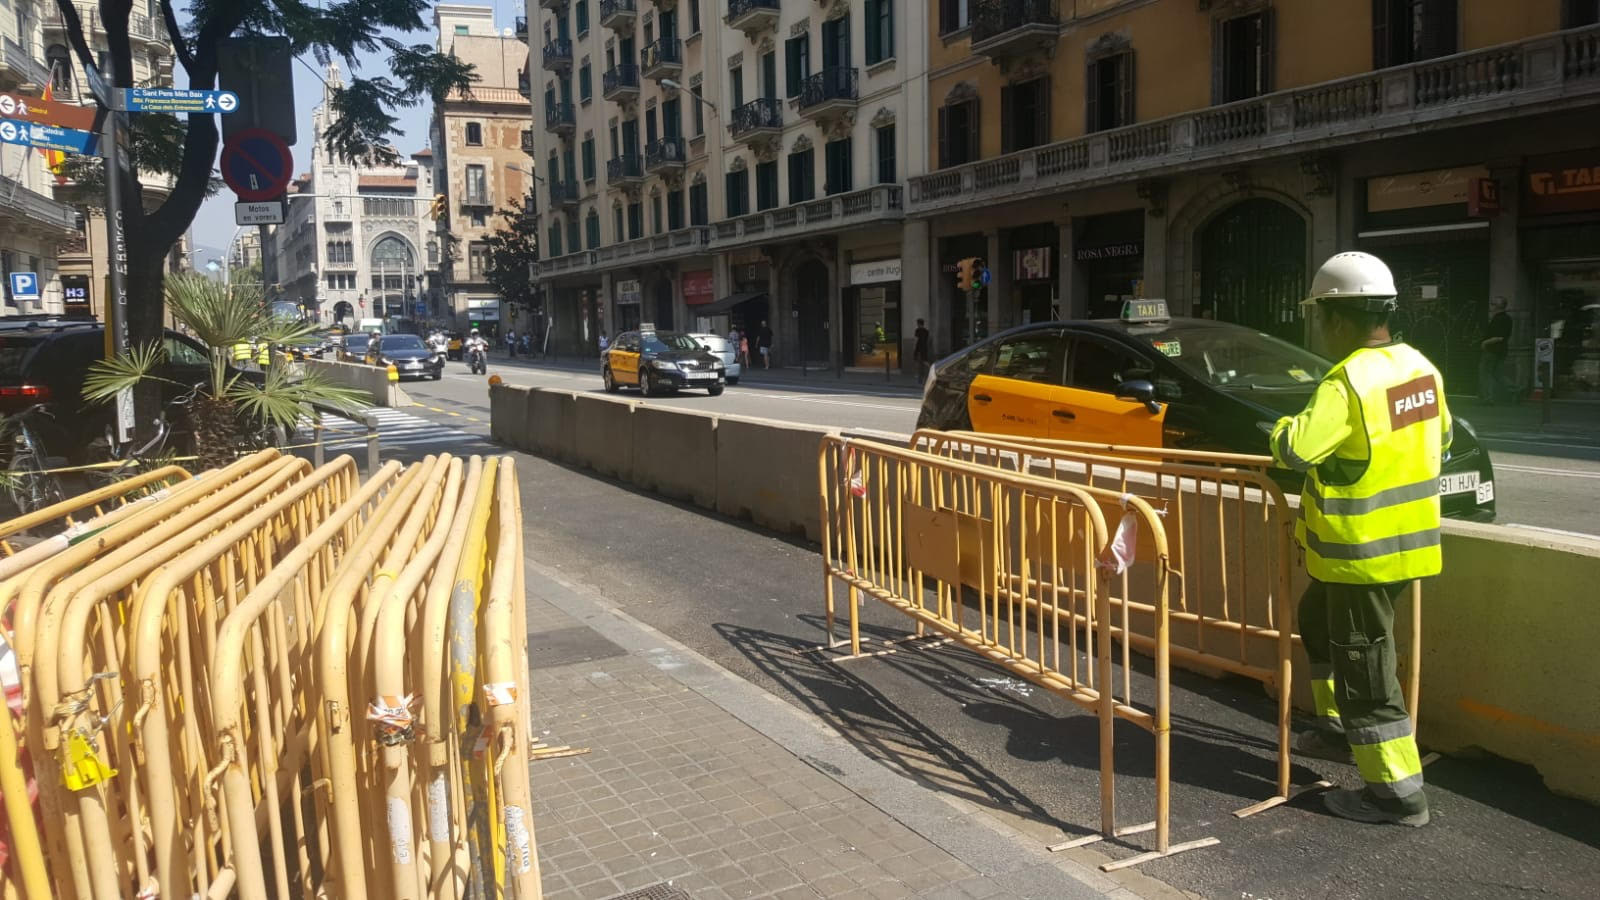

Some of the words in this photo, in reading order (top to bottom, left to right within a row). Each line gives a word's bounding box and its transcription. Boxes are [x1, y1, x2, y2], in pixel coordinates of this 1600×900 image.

[1077, 248, 1102, 260] ROSA
[1104, 244, 1138, 257] NEGRA
[15, 275, 32, 293] P
[66, 287, 85, 297] H3
[1137, 304, 1157, 317] TAXI
[1394, 389, 1436, 416] FAUS
[1458, 474, 1477, 490] HJV
[1479, 483, 1492, 501] SP
